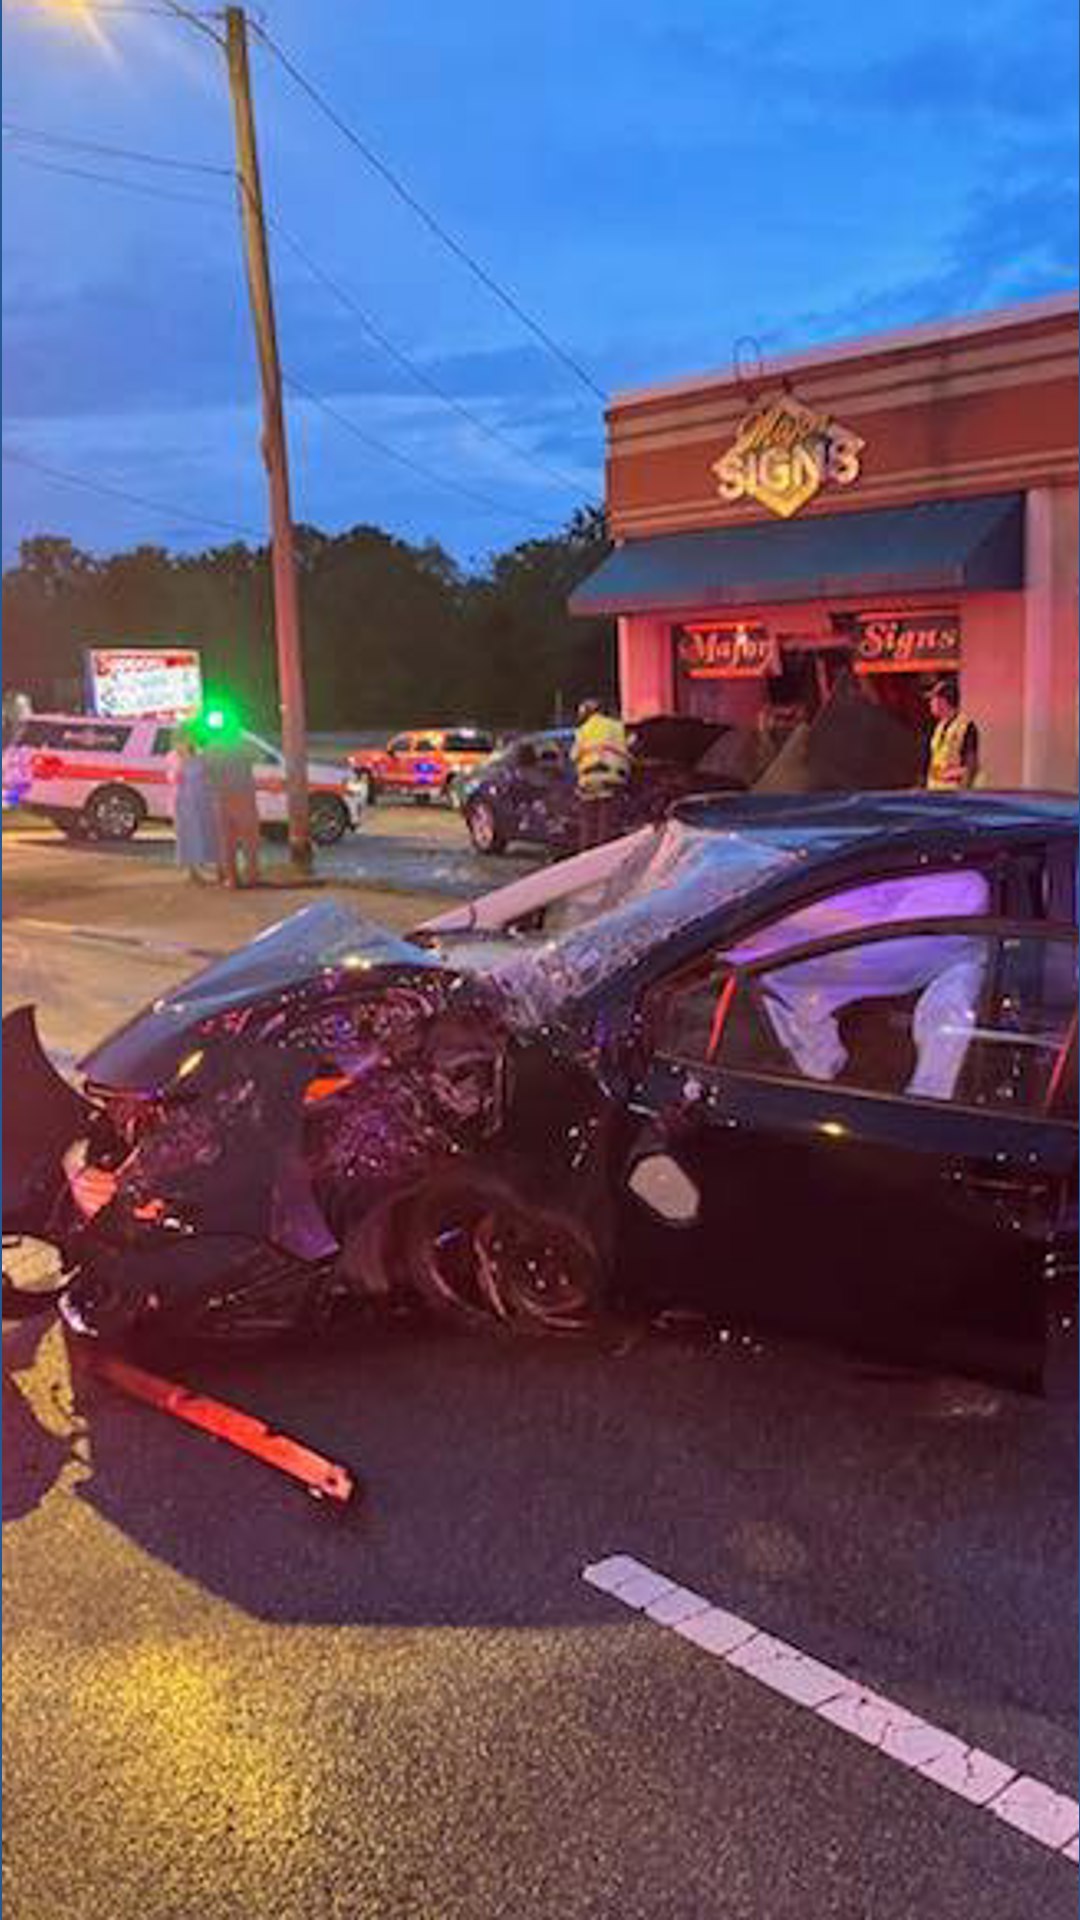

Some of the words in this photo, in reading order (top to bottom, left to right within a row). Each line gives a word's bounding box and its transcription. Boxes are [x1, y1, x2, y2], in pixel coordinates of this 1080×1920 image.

[717, 433, 861, 500] SIGNS
[682, 629, 770, 667] Major
[861, 621, 957, 660] Signs
